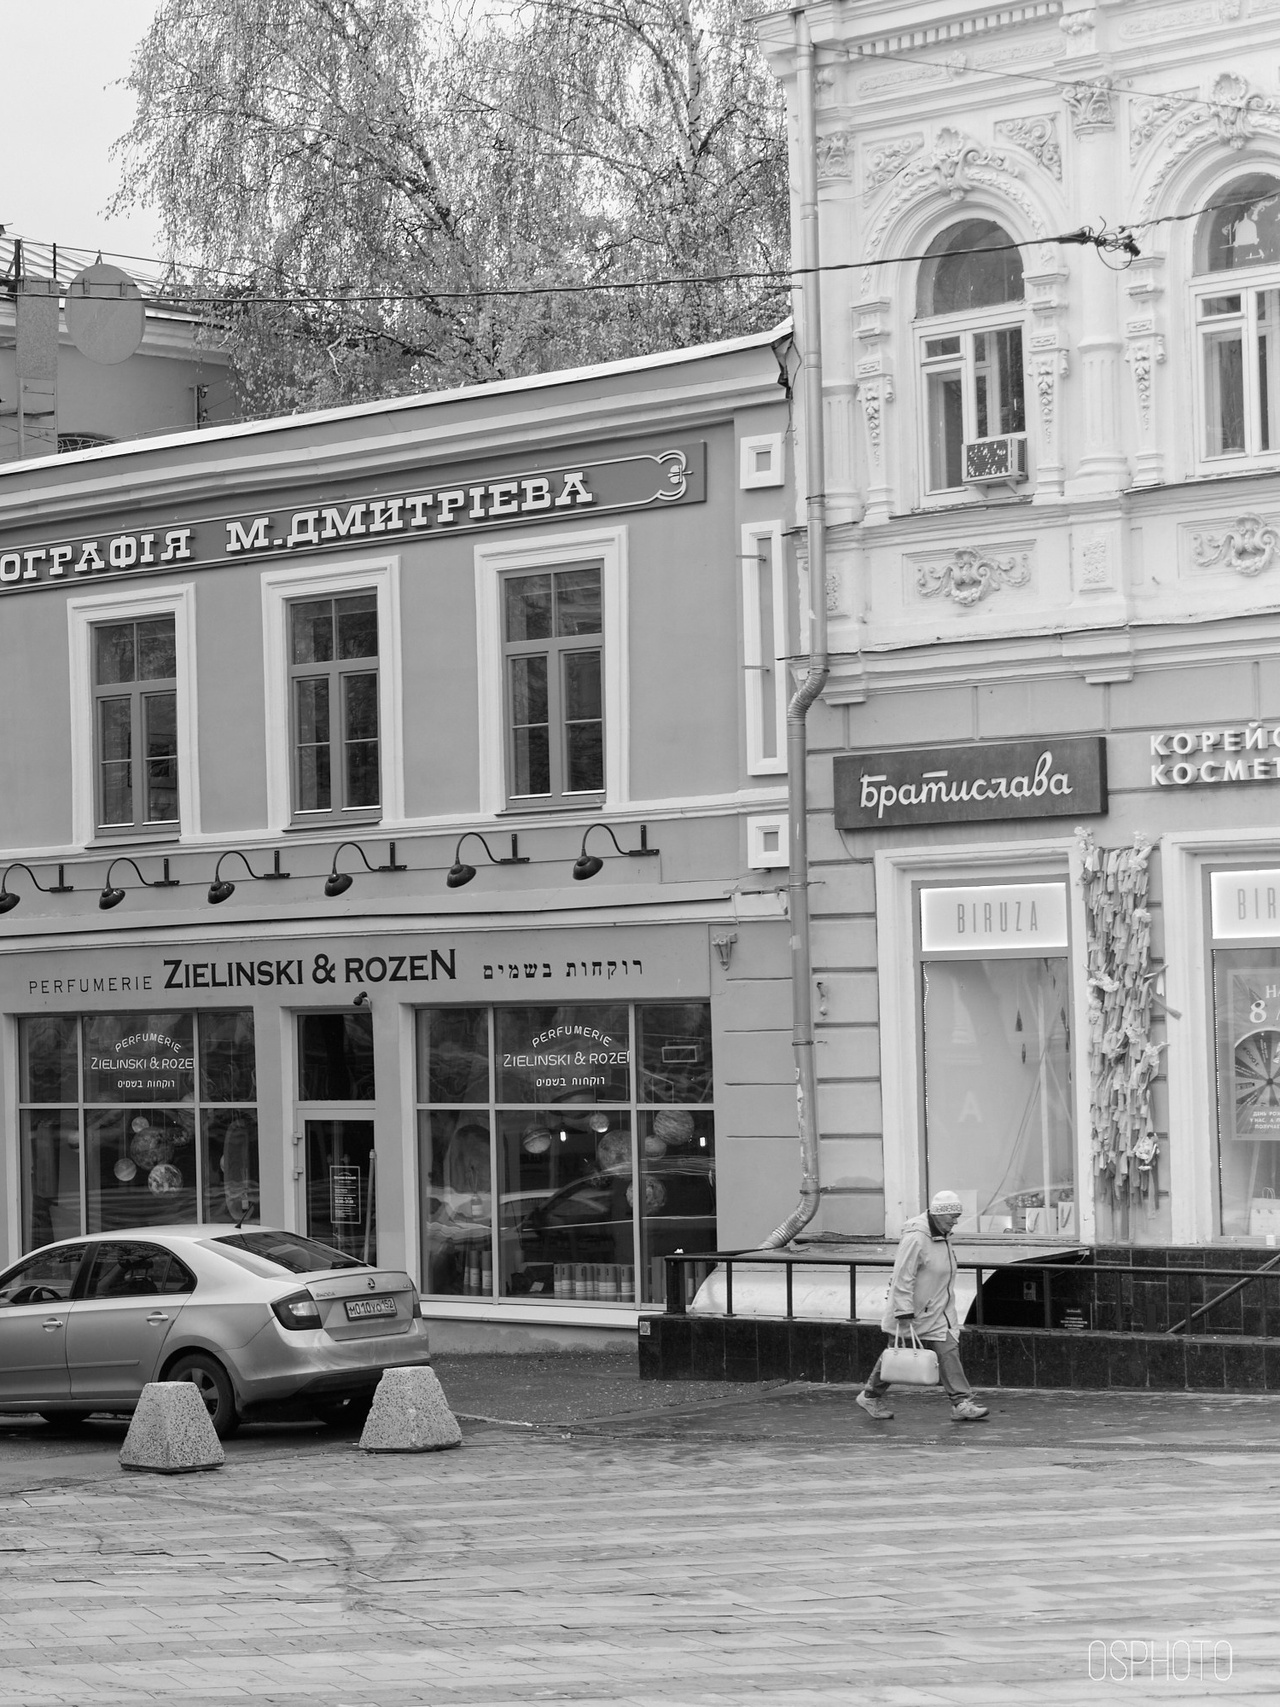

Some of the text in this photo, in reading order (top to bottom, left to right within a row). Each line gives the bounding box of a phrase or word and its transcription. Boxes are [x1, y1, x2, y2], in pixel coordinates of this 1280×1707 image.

[859, 750, 1073, 819] Братислава
[957, 900, 1040, 935] BIRUZA
[28, 948, 457, 995] PERFUMERIE ZIELINSKI & ROZEN
[483, 959, 643, 980] רוקחות בשמים
[115, 1032, 182, 1054] PERFUMERIE
[531, 1025, 612, 1048] PERFUMERIE
[91, 1057, 147, 1070] ZIELINSKI
[149, 1056, 160, 1070] &
[503, 1053, 571, 1067] ZIELINSKI
[574, 1051, 586, 1066] &
